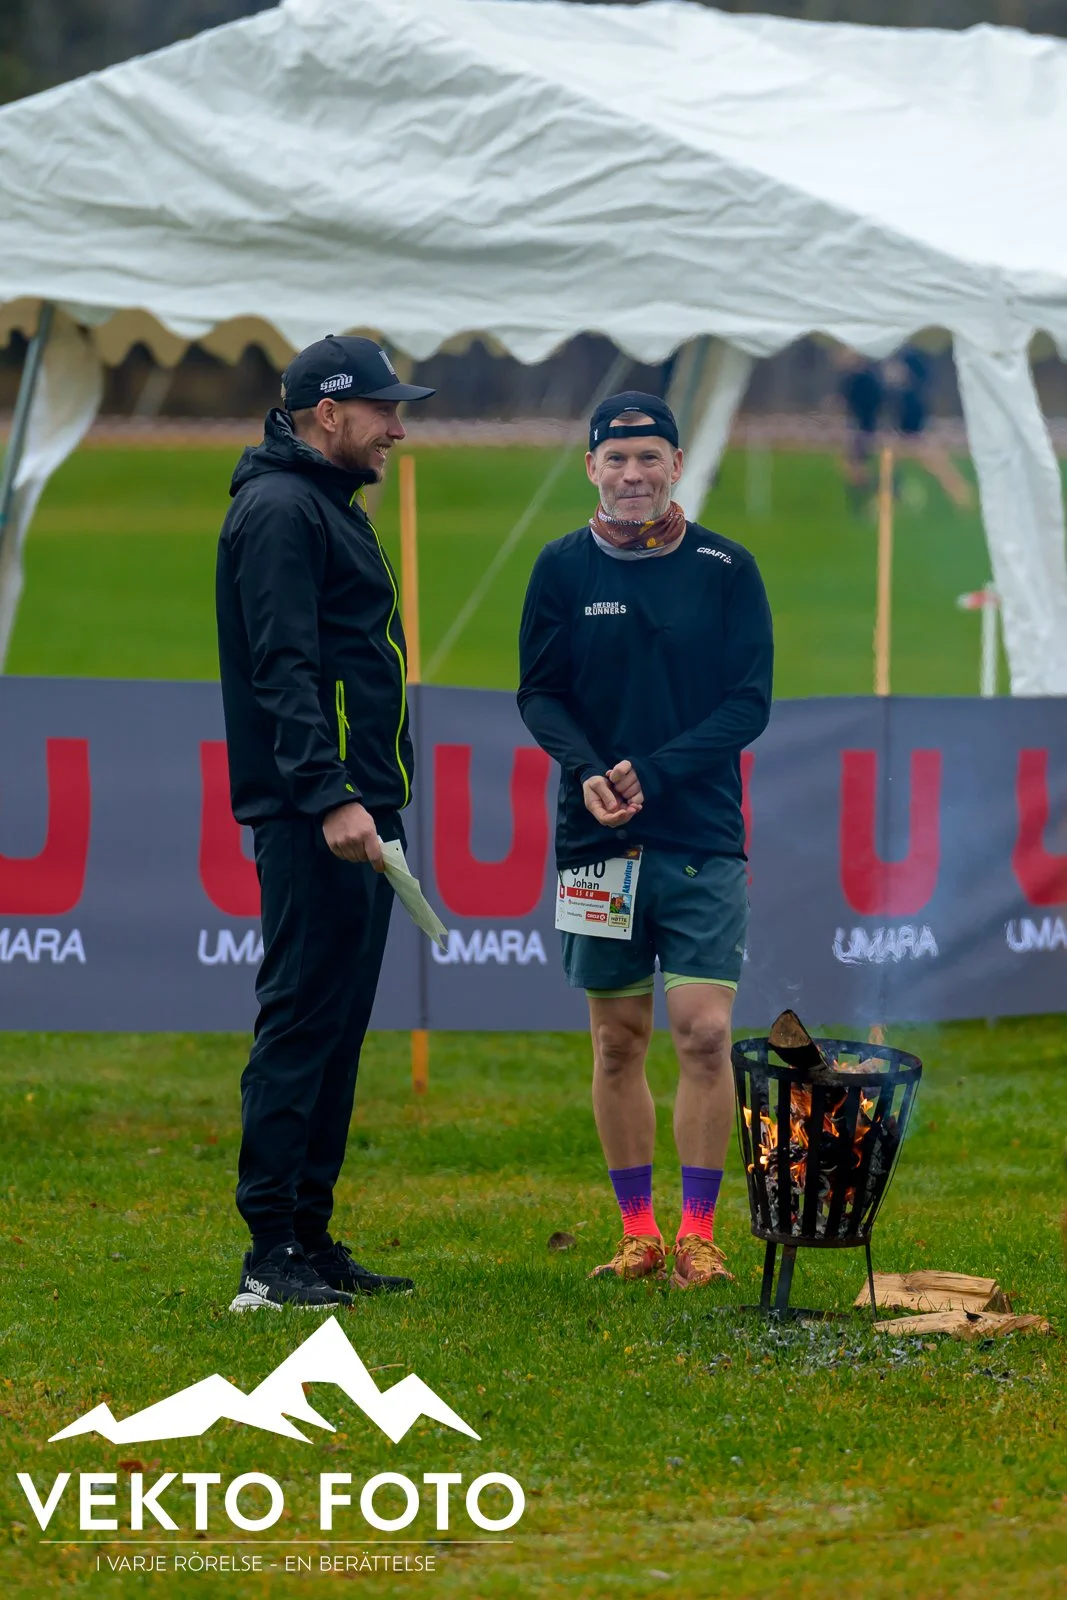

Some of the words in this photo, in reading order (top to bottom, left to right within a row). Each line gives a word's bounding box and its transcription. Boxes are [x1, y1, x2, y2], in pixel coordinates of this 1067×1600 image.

[696, 546, 726, 561] CRAFT
[584, 604, 627, 616] RUNNERS
[572, 878, 600, 890] Johan
[431, 929, 547, 965] UMARA
[244, 1275, 270, 1298] HOKA
